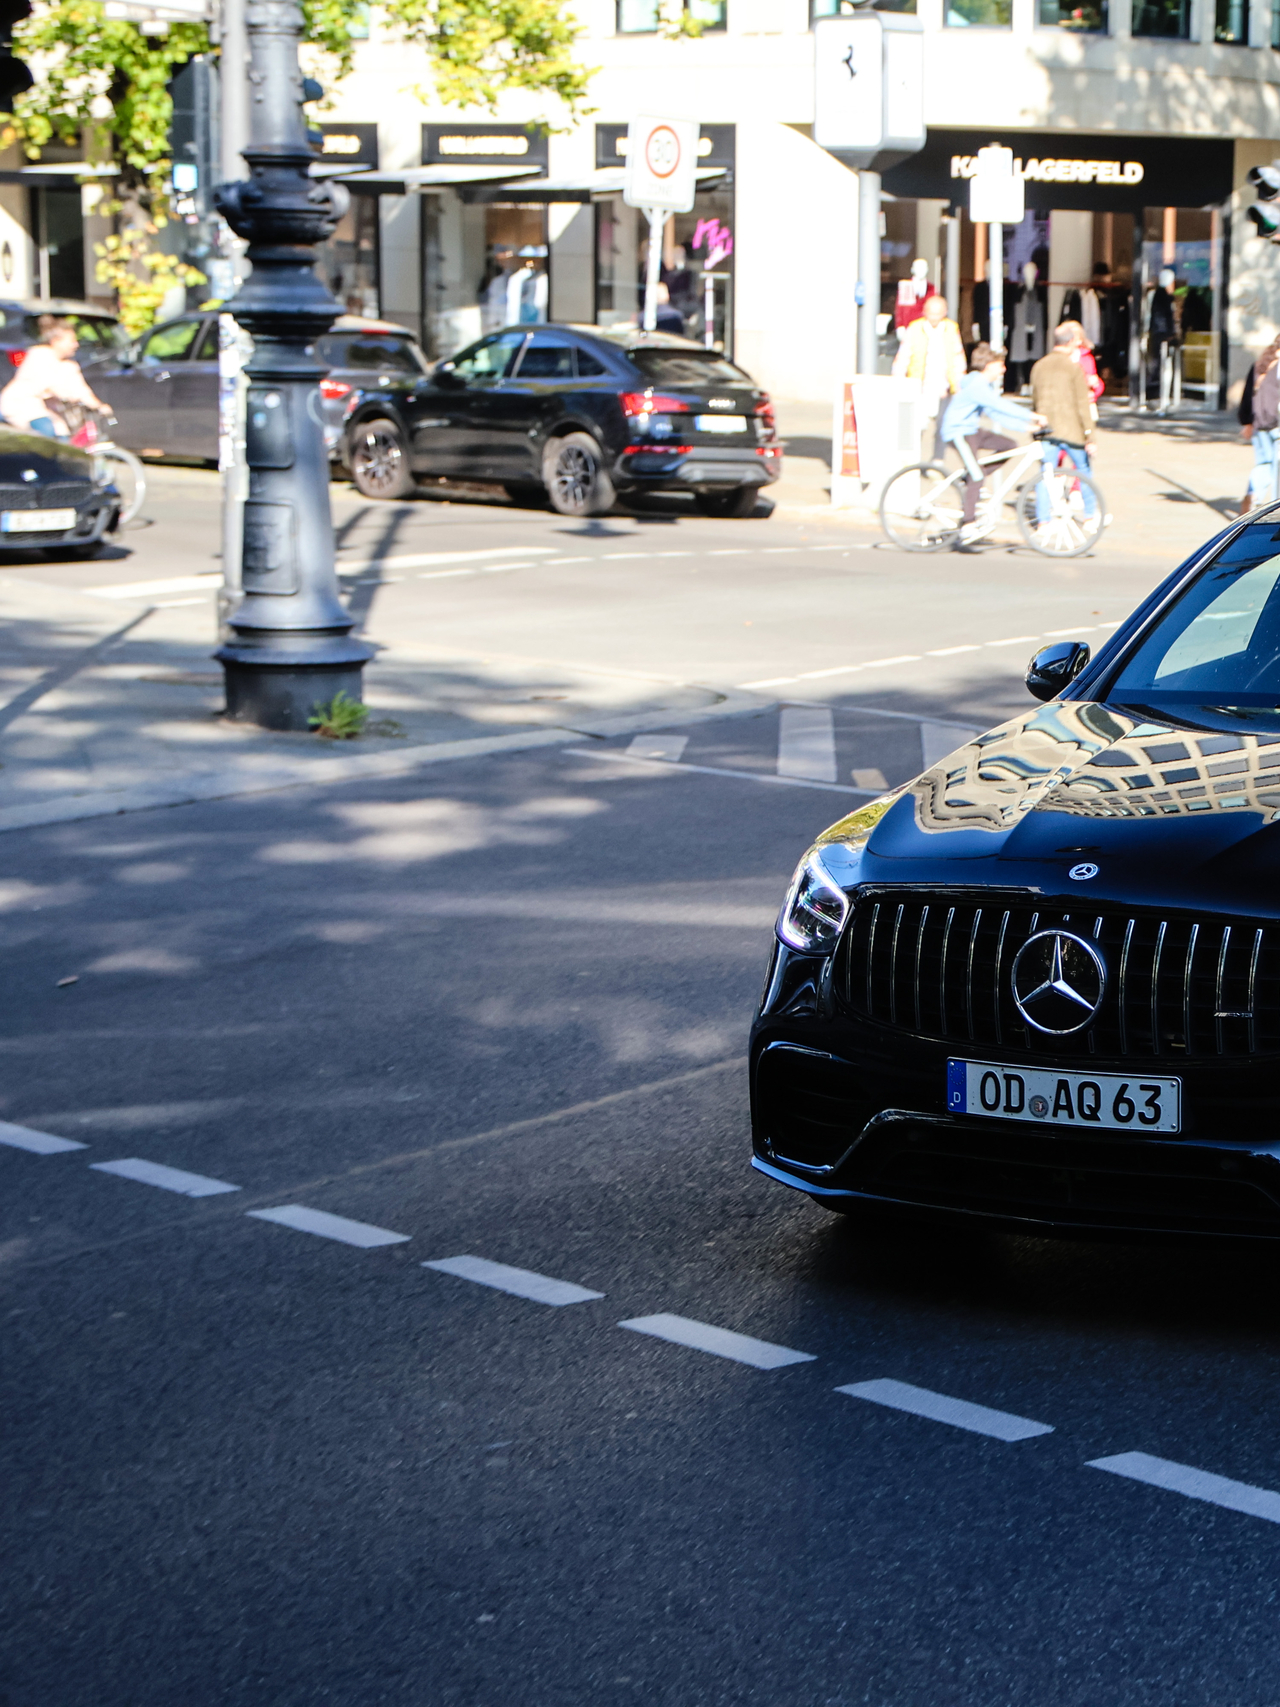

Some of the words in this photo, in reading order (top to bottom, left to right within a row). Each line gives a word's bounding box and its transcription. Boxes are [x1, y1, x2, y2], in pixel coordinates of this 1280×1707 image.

[1013, 157, 1145, 184] LAGERFELD
[953, 1091, 961, 1103] D
[980, 1070, 1025, 1114] OD
[1052, 1078, 1101, 1121] AQ
[1113, 1082, 1162, 1125] 63
